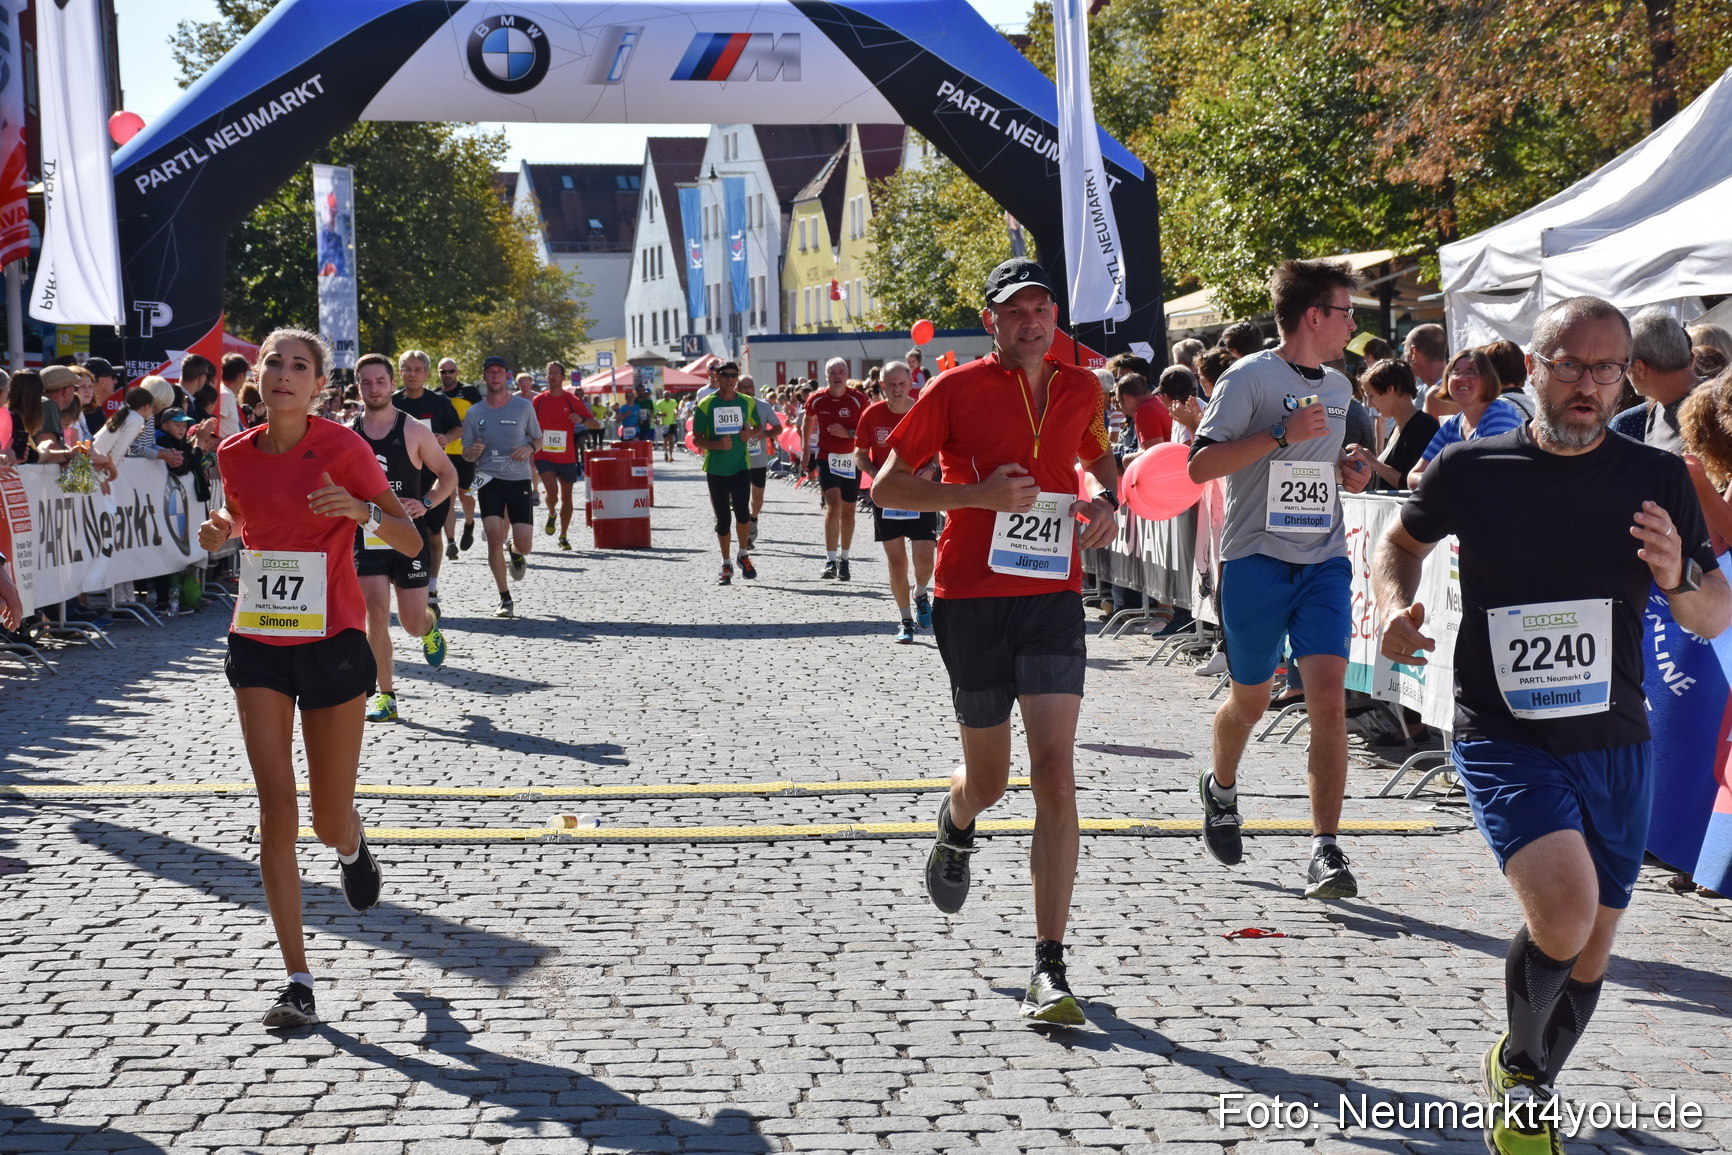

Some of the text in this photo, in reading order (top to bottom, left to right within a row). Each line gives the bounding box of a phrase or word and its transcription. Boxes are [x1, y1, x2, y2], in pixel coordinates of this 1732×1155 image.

[937, 81, 1000, 130] PARTL
[135, 74, 324, 194] PARTL NEUMARKT
[718, 414, 739, 424] 3018
[548, 436, 561, 444] 162
[831, 459, 852, 468] 2149
[1292, 467, 1321, 476] BOCK
[1280, 481, 1329, 504] 2343
[1031, 500, 1057, 511] OCK
[1284, 515, 1324, 527] Christoph
[38, 496, 84, 570] PARTL
[1006, 513, 1061, 543] 2241
[1010, 543, 1029, 551] PARTL
[262, 558, 299, 569] BOCK
[1015, 555, 1049, 570] Jürgen
[407, 571, 427, 580] SINGER
[257, 574, 304, 600] 147
[259, 615, 299, 628] Simone
[1522, 612, 1578, 628] BOCK
[1509, 633, 1596, 673] 2240
[1519, 673, 1581, 685] PARTL Neumarkt
[1531, 689, 1581, 707] Helmut
